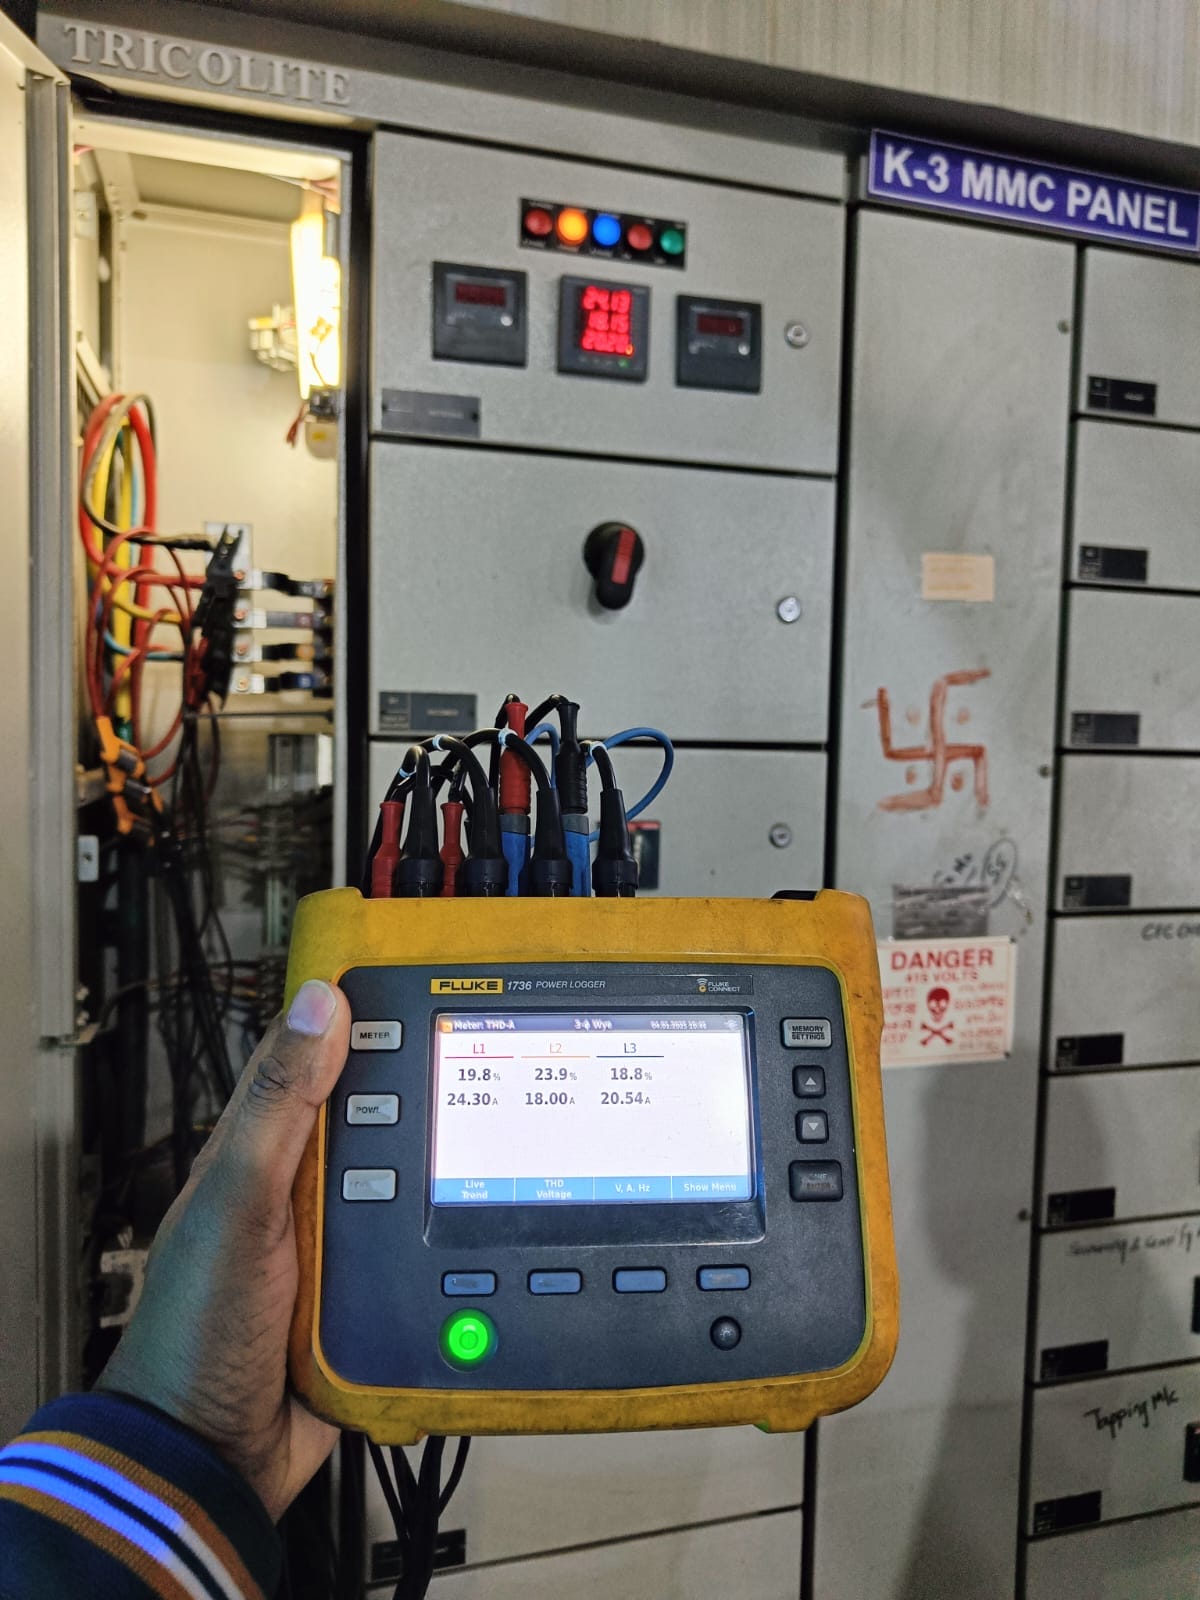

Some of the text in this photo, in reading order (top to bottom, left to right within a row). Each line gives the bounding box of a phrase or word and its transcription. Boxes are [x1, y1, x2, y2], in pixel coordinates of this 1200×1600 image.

[64, 23, 349, 107] TRICOLITE
[883, 143, 1189, 237] K-3 MMC PANEL
[890, 947, 993, 971] DANGER
[439, 980, 606, 990] FLUKE 1736 POWER LOGGER
[360, 1031, 390, 1039] METER
[473, 1043, 486, 1054] L1
[549, 1043, 562, 1054] L2
[623, 1043, 637, 1054] L3
[458, 1068, 491, 1081] 19.8
[535, 1068, 568, 1081] 23.9
[610, 1067, 643, 1080] 18.8
[447, 1092, 491, 1105] 24.30
[525, 1092, 568, 1105] 18.00
[600, 1091, 644, 1105] 20.54
[465, 1179, 485, 1188] Live
[544, 1179, 564, 1188] THD
[639, 1184, 650, 1192] Hz
[684, 1182, 737, 1192] Show Menu
[461, 1190, 488, 1199] Trend
[536, 1190, 572, 1200] Voltage
